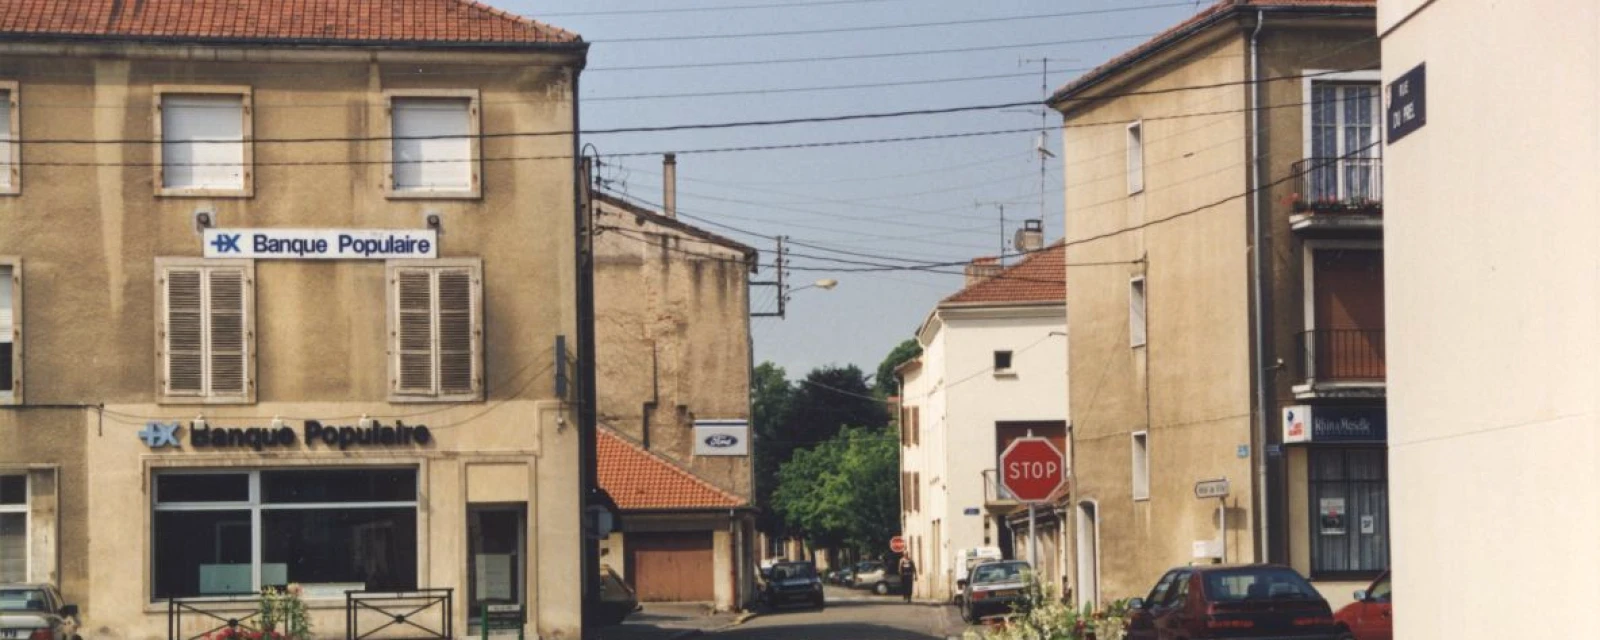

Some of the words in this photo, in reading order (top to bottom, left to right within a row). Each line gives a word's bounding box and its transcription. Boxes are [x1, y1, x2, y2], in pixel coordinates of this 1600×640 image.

[1393, 109, 1401, 129] DU
[253, 234, 328, 257] Banque
[338, 234, 431, 257] Populaire
[190, 421, 296, 451] Banque
[304, 420, 430, 451] Populaire
[710, 435, 732, 448] Ford
[1009, 461, 1058, 479] STOP
